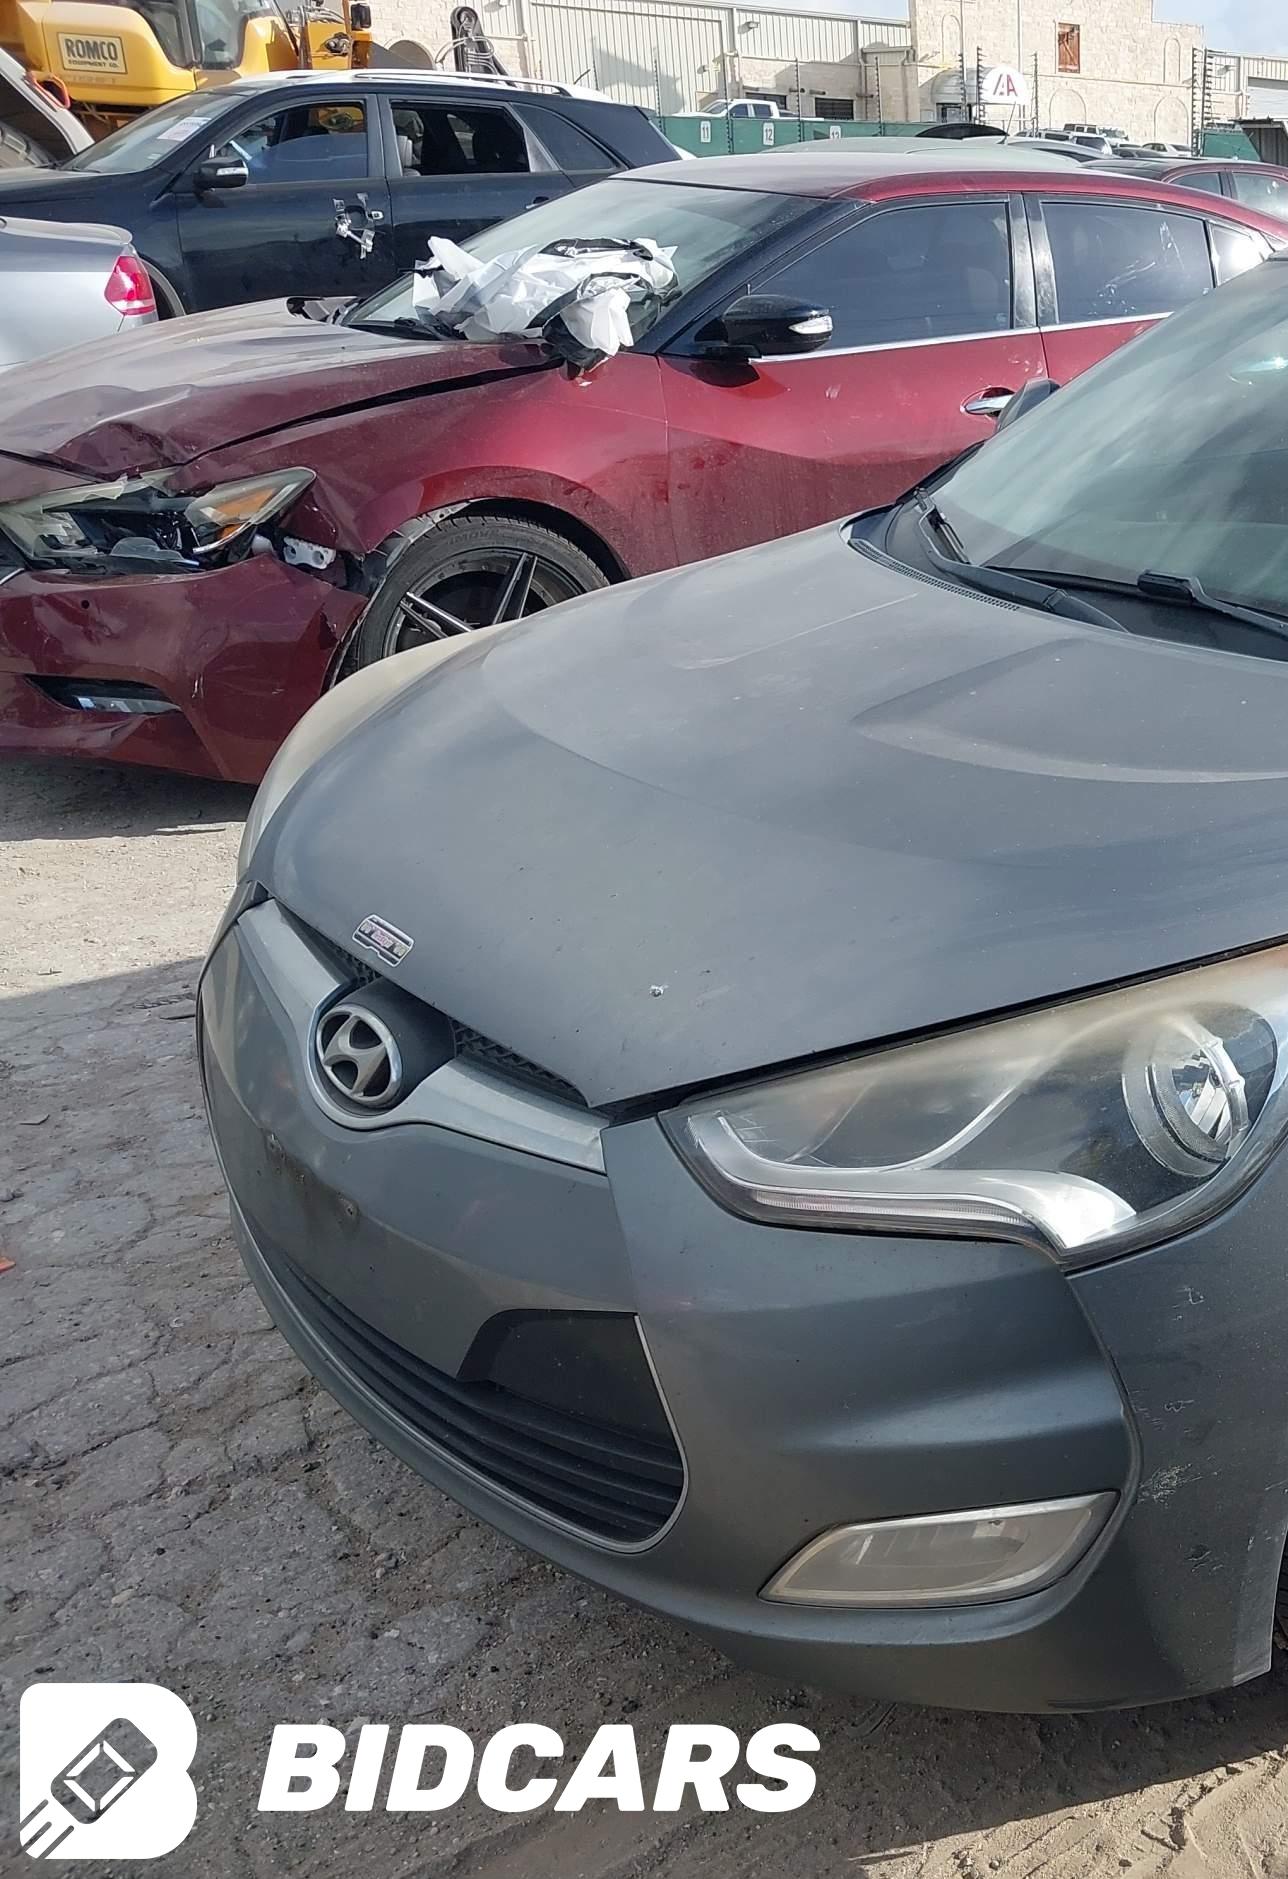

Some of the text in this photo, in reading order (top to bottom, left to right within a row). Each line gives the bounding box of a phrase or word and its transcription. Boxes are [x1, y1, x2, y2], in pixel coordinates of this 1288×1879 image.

[64, 38, 118, 61] ROMCO
[67, 59, 107, 67] EQUIPMENT
[702, 126, 710, 139] 11
[765, 129, 773, 142] 12
